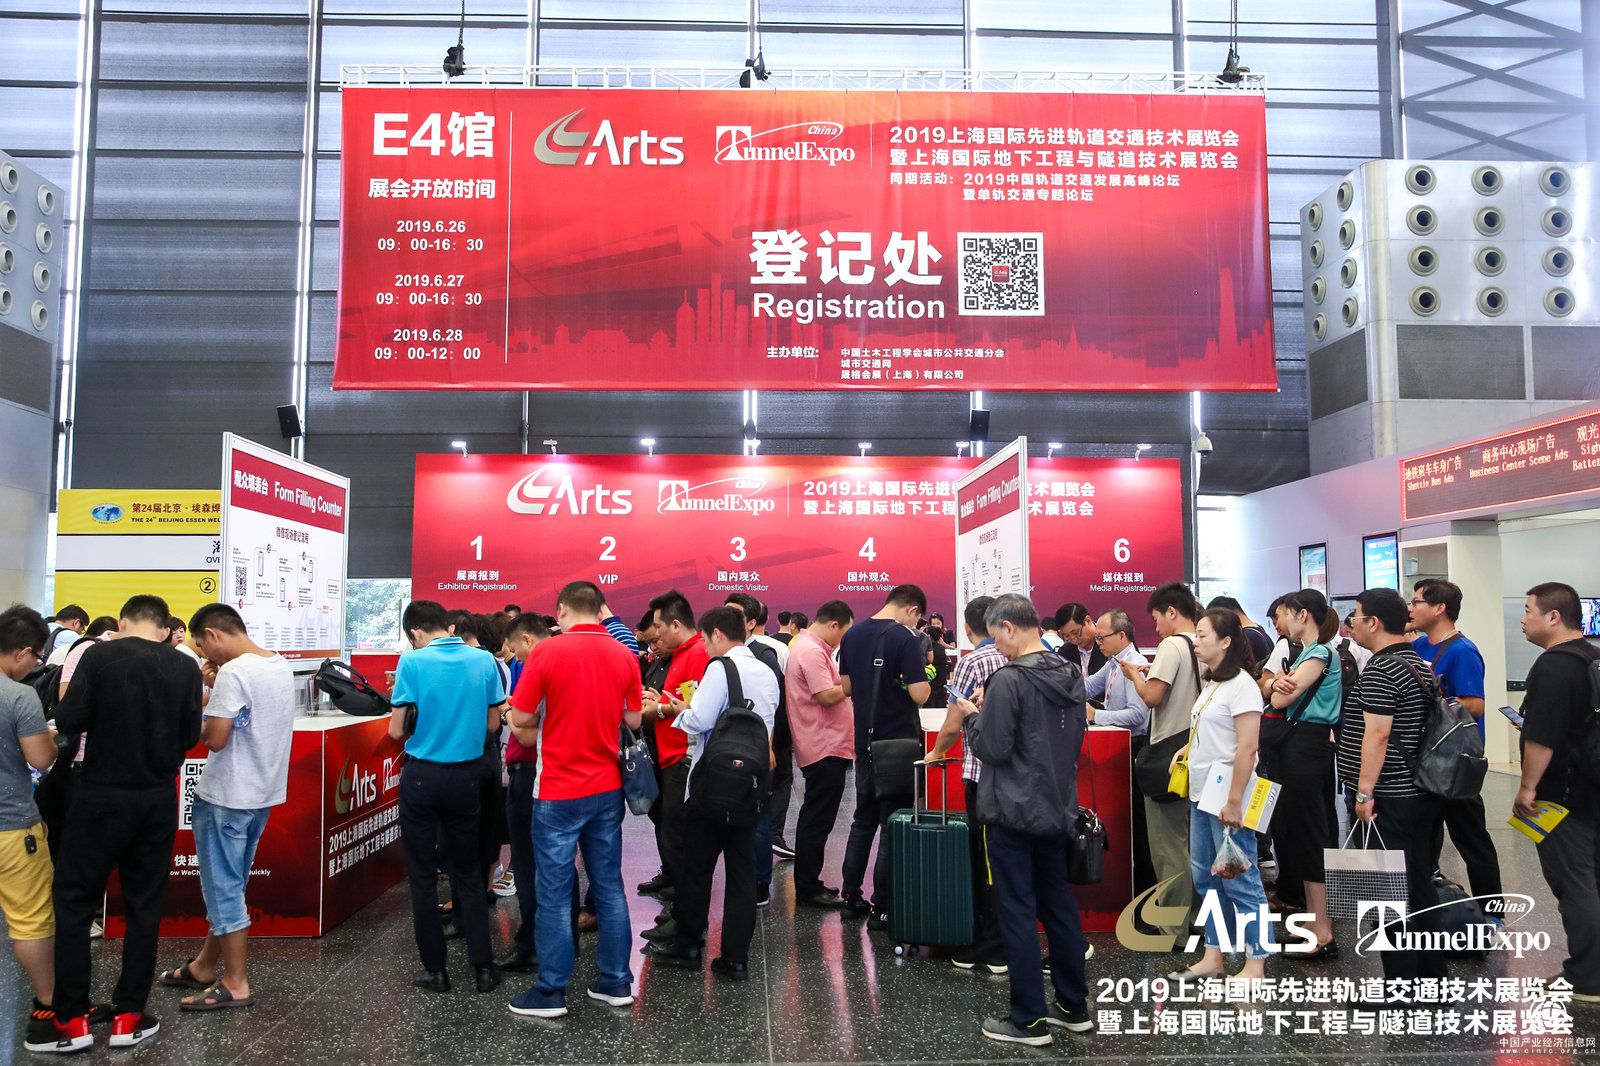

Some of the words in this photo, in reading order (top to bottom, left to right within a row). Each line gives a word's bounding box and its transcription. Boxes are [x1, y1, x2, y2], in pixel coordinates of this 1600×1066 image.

[372, 111, 496, 158] E4馆
[807, 122, 838, 136] China
[889, 126, 1241, 147] 2019上海国际先进轨道交通技术展览会
[584, 119, 685, 166] Arts
[714, 125, 856, 168] TunnelExpo
[889, 148, 1239, 169] 暨上海国际地下工程与隧道技术展览会
[368, 178, 496, 199] 展会开放时间
[962, 188, 1094, 202] 暨单轨交通专题论坛
[396, 220, 466, 233] 2019.6.26
[749, 229, 943, 287] 登记处
[394, 274, 465, 287] 2019.6.27
[753, 293, 945, 325] Registration
[393, 329, 463, 342] 2019.6.28
[840, 358, 892, 369] 城市交通网
[1469, 466, 1500, 478] Business
[1502, 459, 1527, 472] Center
[1529, 453, 1551, 466] Scene
[1554, 448, 1569, 461] Ads
[274, 481, 295, 503] Form
[295, 488, 317, 514] Filling
[317, 495, 343, 518] Counter
[549, 473, 633, 515] Arts
[657, 480, 776, 516] TunnelExpo
[470, 535, 483, 561] 1
[598, 535, 617, 562] 2
[729, 536, 747, 563] 3
[858, 537, 877, 563] 4
[1113, 537, 1131, 563] 6
[456, 570, 500, 582] 展商报到
[598, 573, 619, 585] VIP
[717, 570, 761, 582] 国内观众
[847, 571, 890, 583] 国外观众
[1102, 572, 1144, 583] 媒体报到
[437, 582, 471, 592] Exhibitor
[472, 582, 518, 593] Registration
[708, 582, 741, 592] Domestic
[743, 582, 769, 592] Visitor
[838, 583, 874, 592] Overseas
[1089, 584, 1113, 592] Media
[1114, 584, 1157, 594] Registration
[349, 763, 377, 811] Arts
